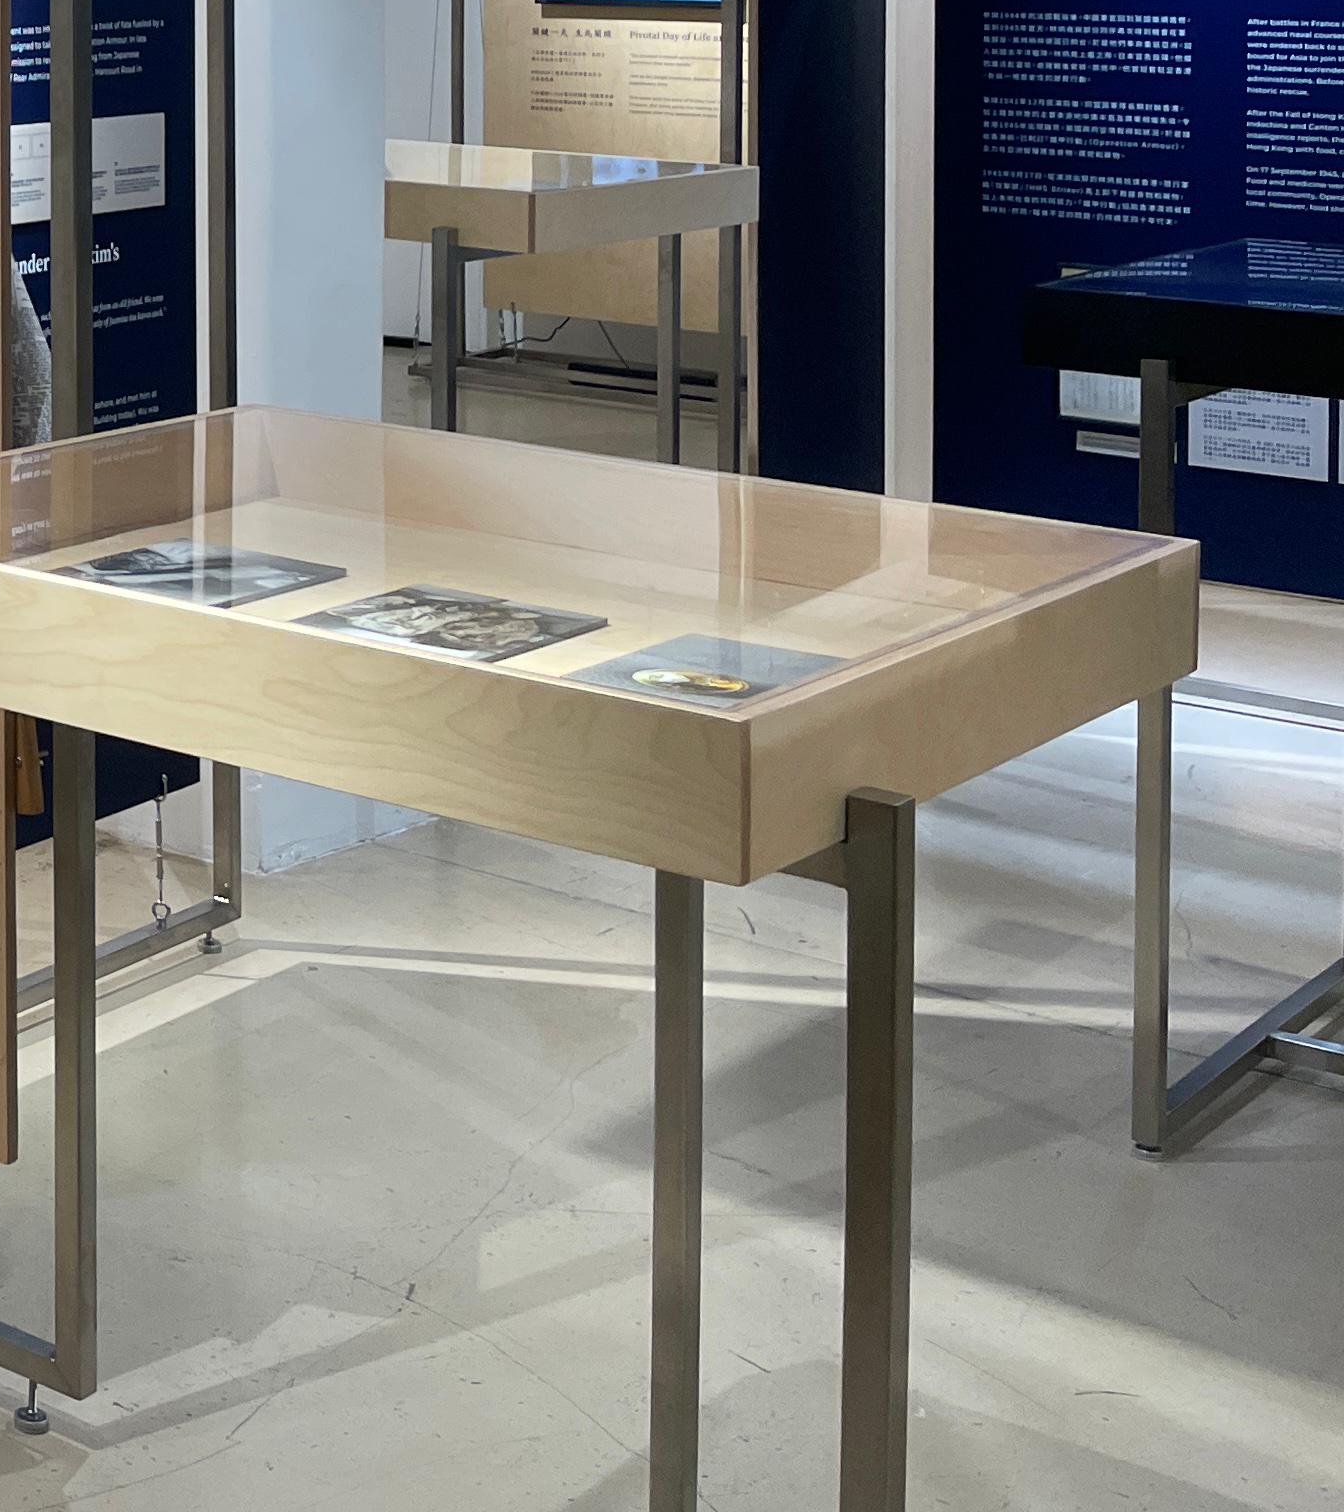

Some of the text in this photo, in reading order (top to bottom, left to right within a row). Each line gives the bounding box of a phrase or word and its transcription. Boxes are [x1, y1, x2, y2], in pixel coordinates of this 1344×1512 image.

[630, 31, 711, 42] Pivotal Day of Life
